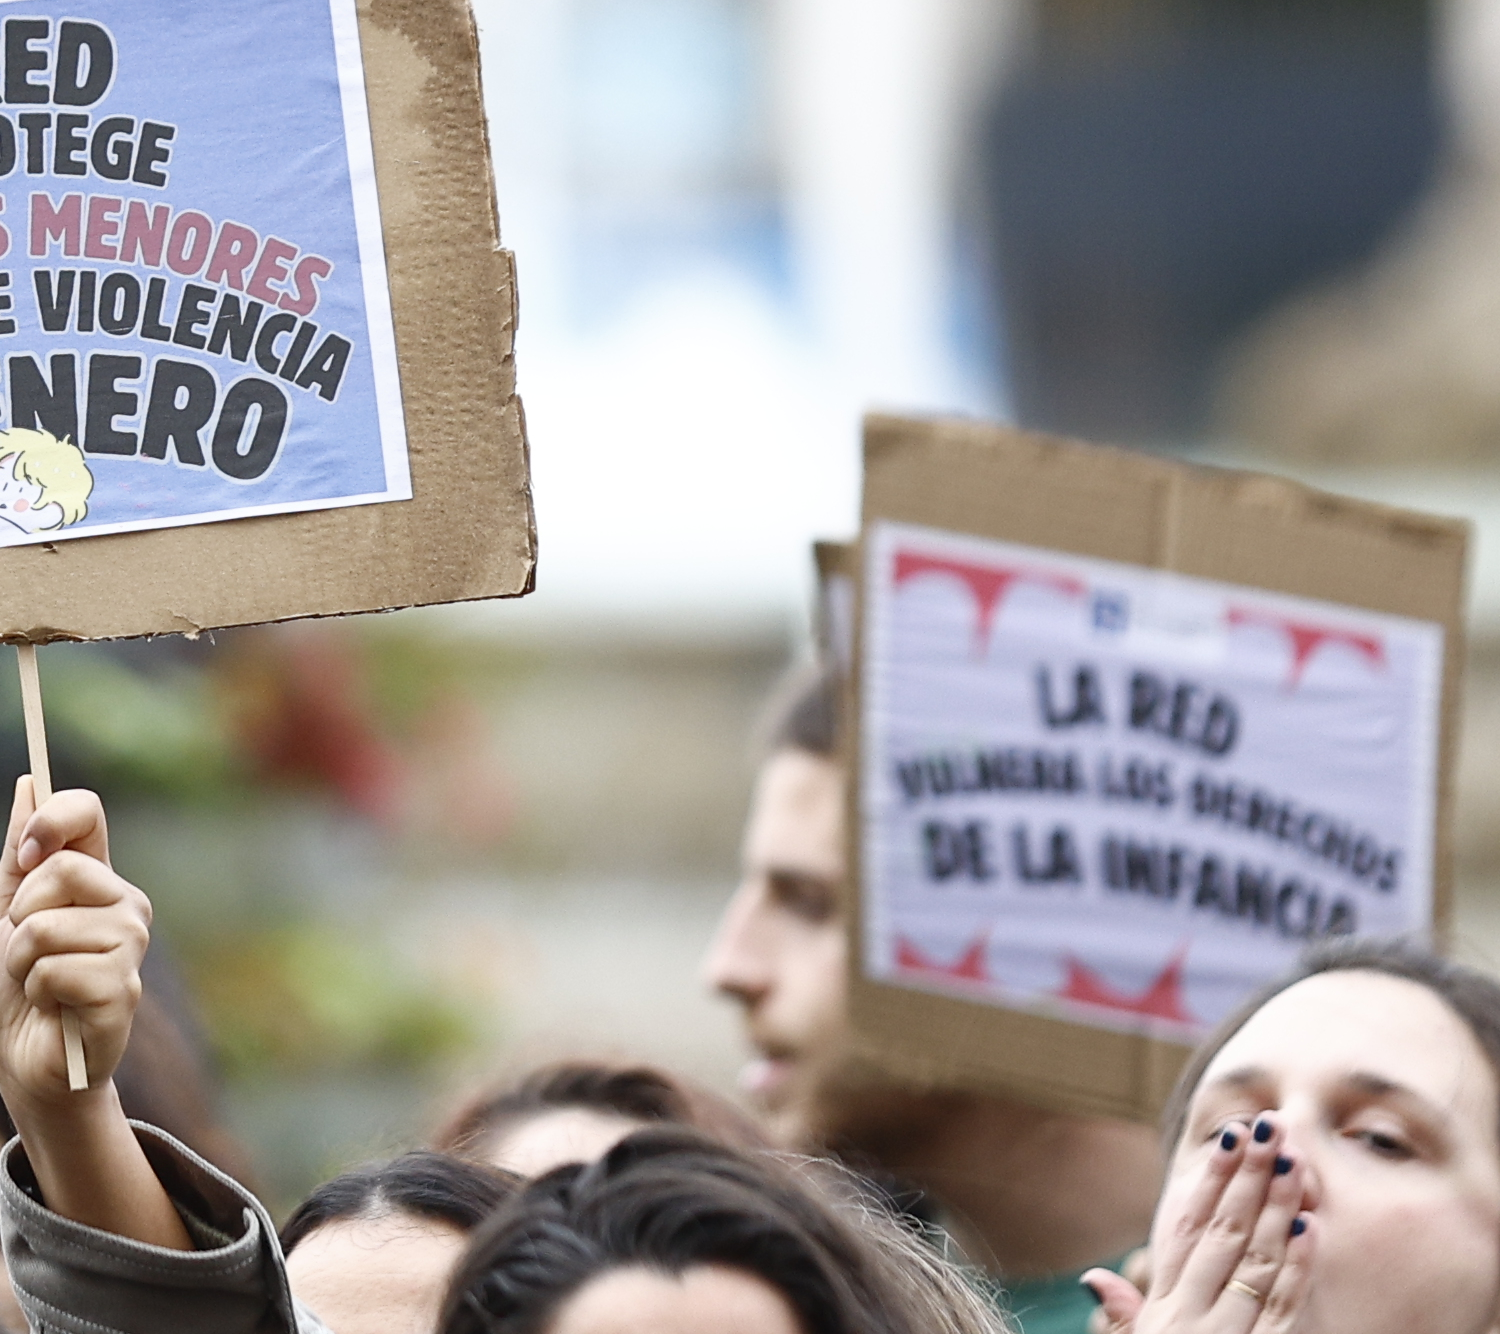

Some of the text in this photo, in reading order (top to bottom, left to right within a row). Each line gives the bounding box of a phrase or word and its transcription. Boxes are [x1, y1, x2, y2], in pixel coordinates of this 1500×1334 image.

[30, 195, 332, 315] MENORES
[34, 269, 351, 402] VIOLENCIA
[1036, 664, 1241, 758] LA RED
[896, 749, 1401, 892] VULNERA LOS DERECHOS
[923, 820, 993, 884] DE
[1012, 822, 1084, 884] LA
